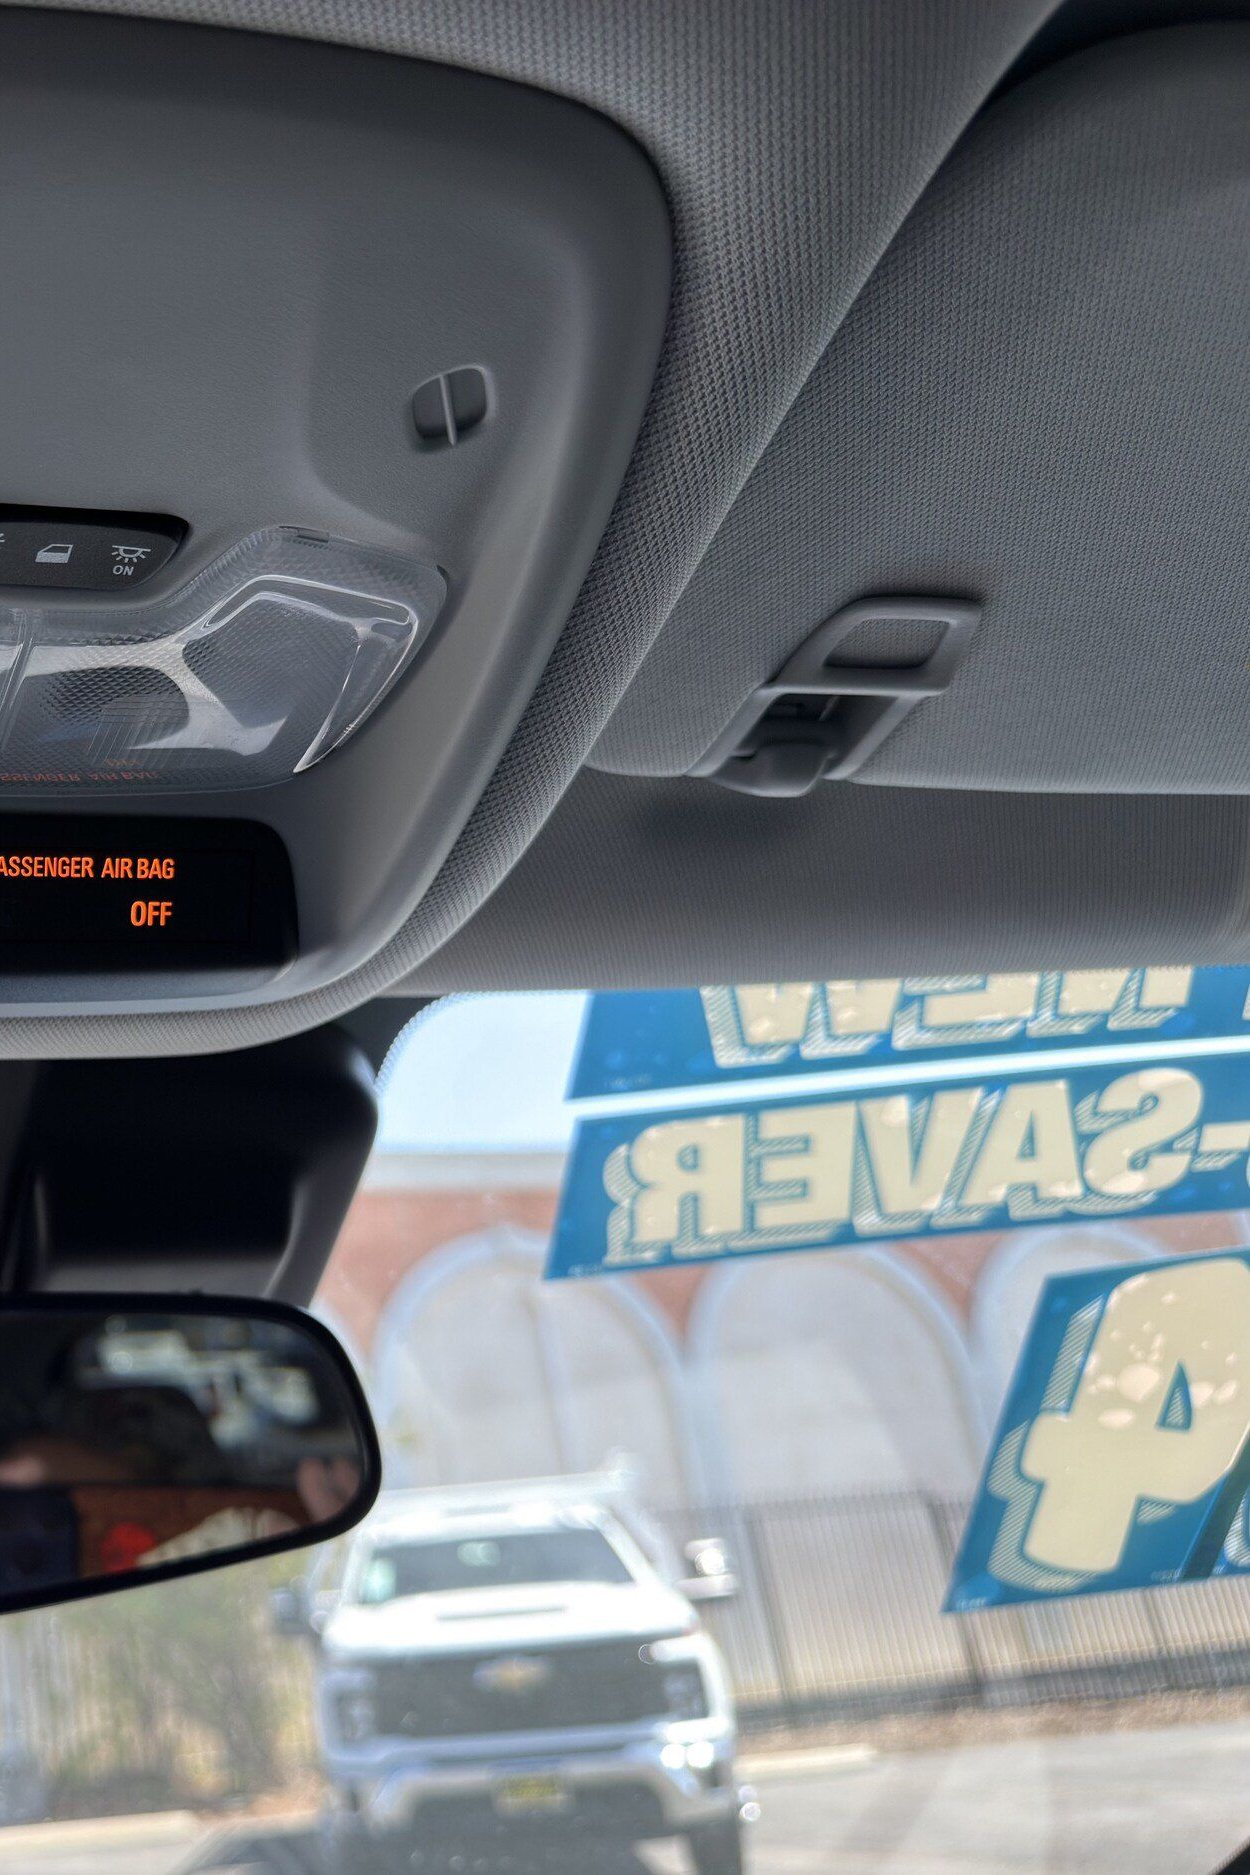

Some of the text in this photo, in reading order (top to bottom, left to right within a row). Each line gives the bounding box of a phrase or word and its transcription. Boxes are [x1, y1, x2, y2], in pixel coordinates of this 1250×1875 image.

[112, 565, 134, 576] ON
[100, 857, 133, 879] AIR
[136, 857, 175, 880] BAG
[130, 900, 173, 927] OFF
